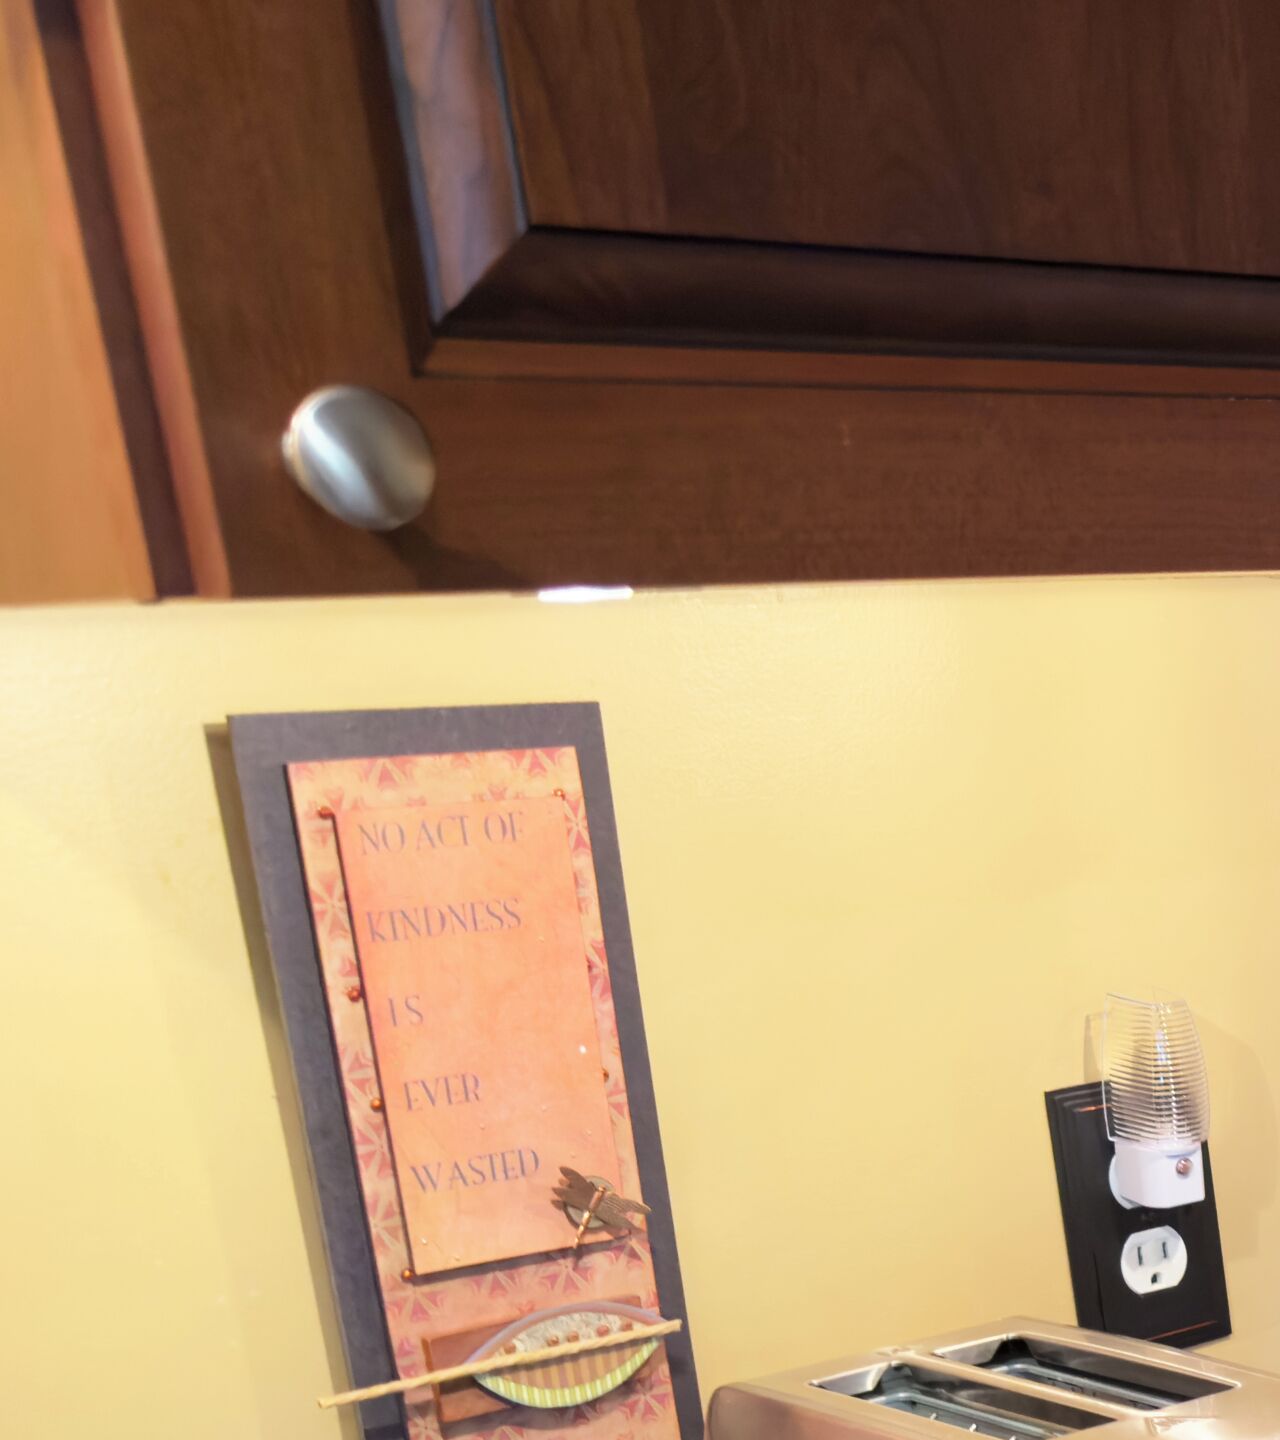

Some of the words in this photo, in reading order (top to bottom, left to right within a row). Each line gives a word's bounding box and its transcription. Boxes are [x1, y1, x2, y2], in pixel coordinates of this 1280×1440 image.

[357, 822, 406, 856] NO
[417, 814, 470, 852] ACT
[484, 811, 525, 844] OF
[366, 898, 522, 943] KINDNESS
[387, 995, 424, 1028] IS
[402, 1072, 481, 1112] EVER
[410, 1147, 541, 1193] WASTED
